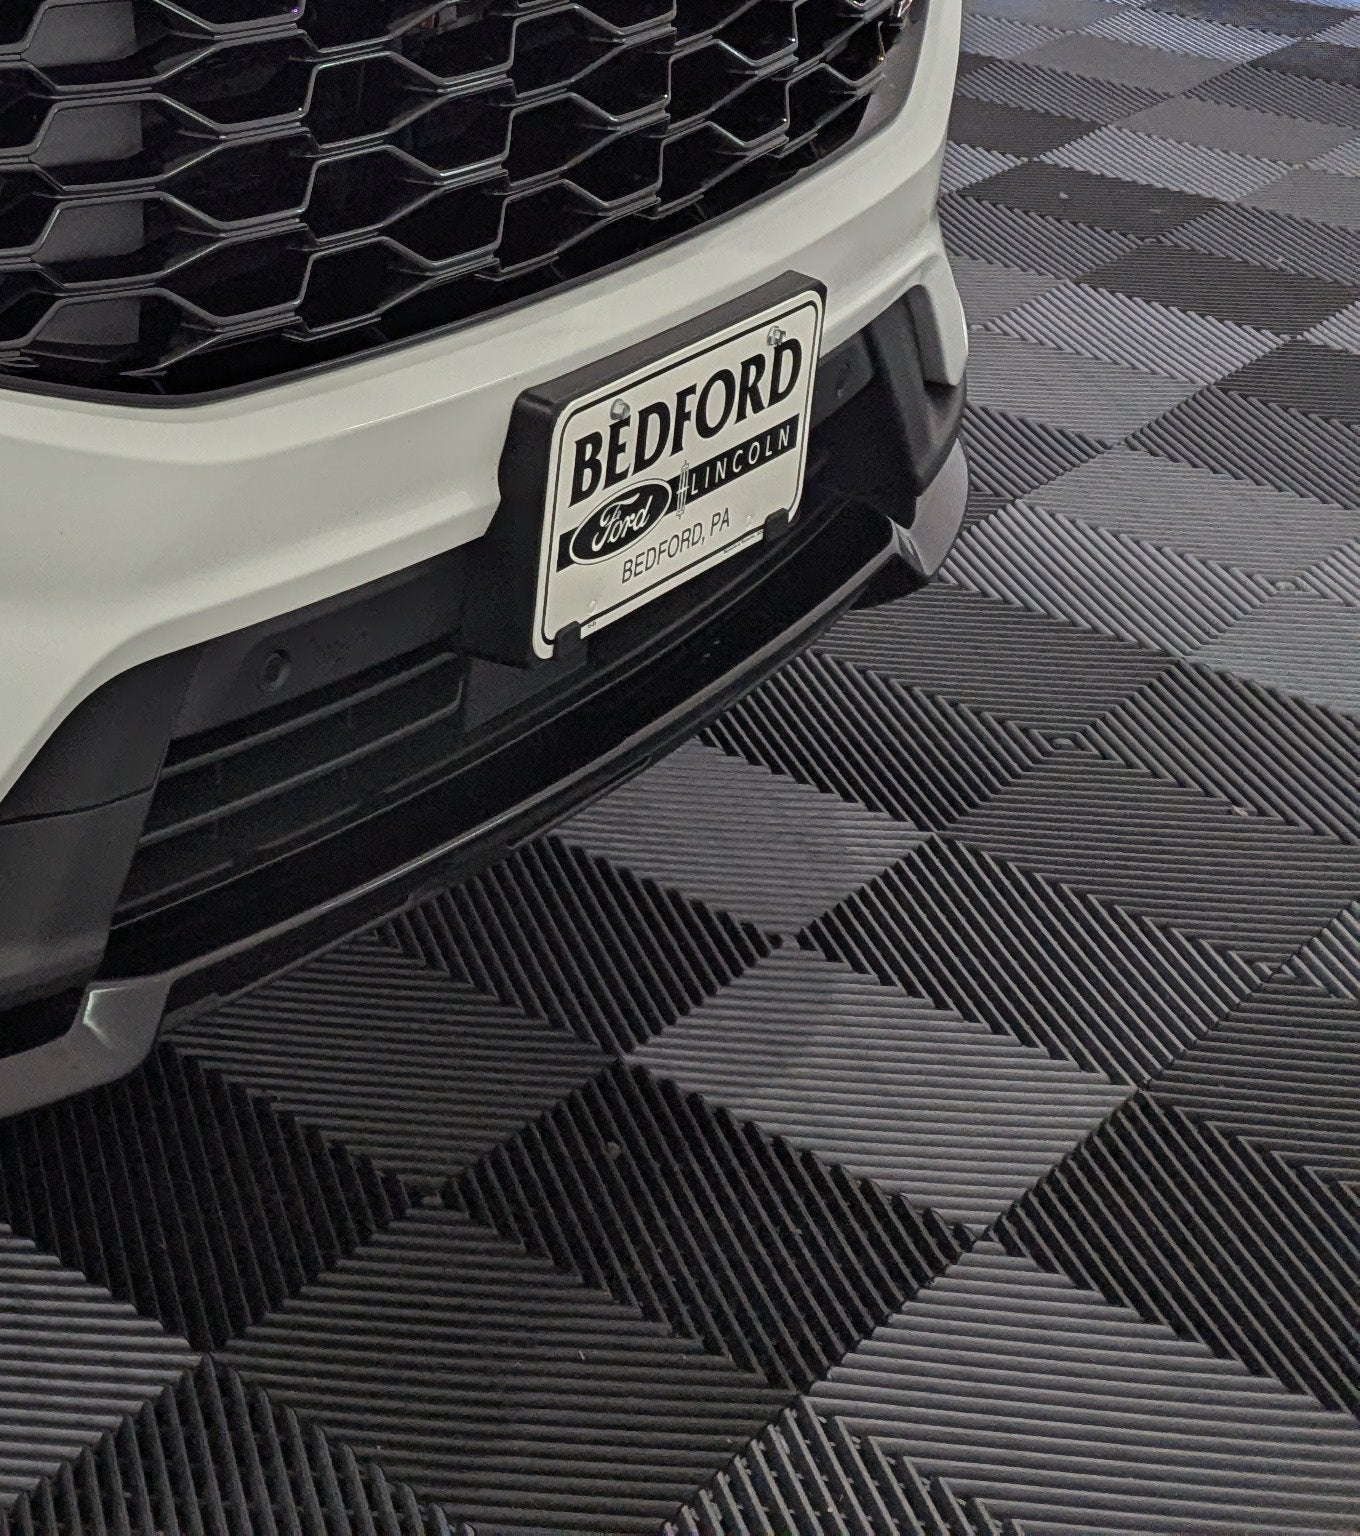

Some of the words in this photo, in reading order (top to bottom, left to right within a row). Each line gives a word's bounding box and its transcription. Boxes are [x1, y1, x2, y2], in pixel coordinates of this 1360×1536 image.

[569, 338, 802, 508] BEDFORD
[690, 425, 791, 495] LINCOLN
[591, 492, 654, 552] Ford
[622, 522, 705, 584] BEDFORD,
[710, 507, 730, 537] PA
